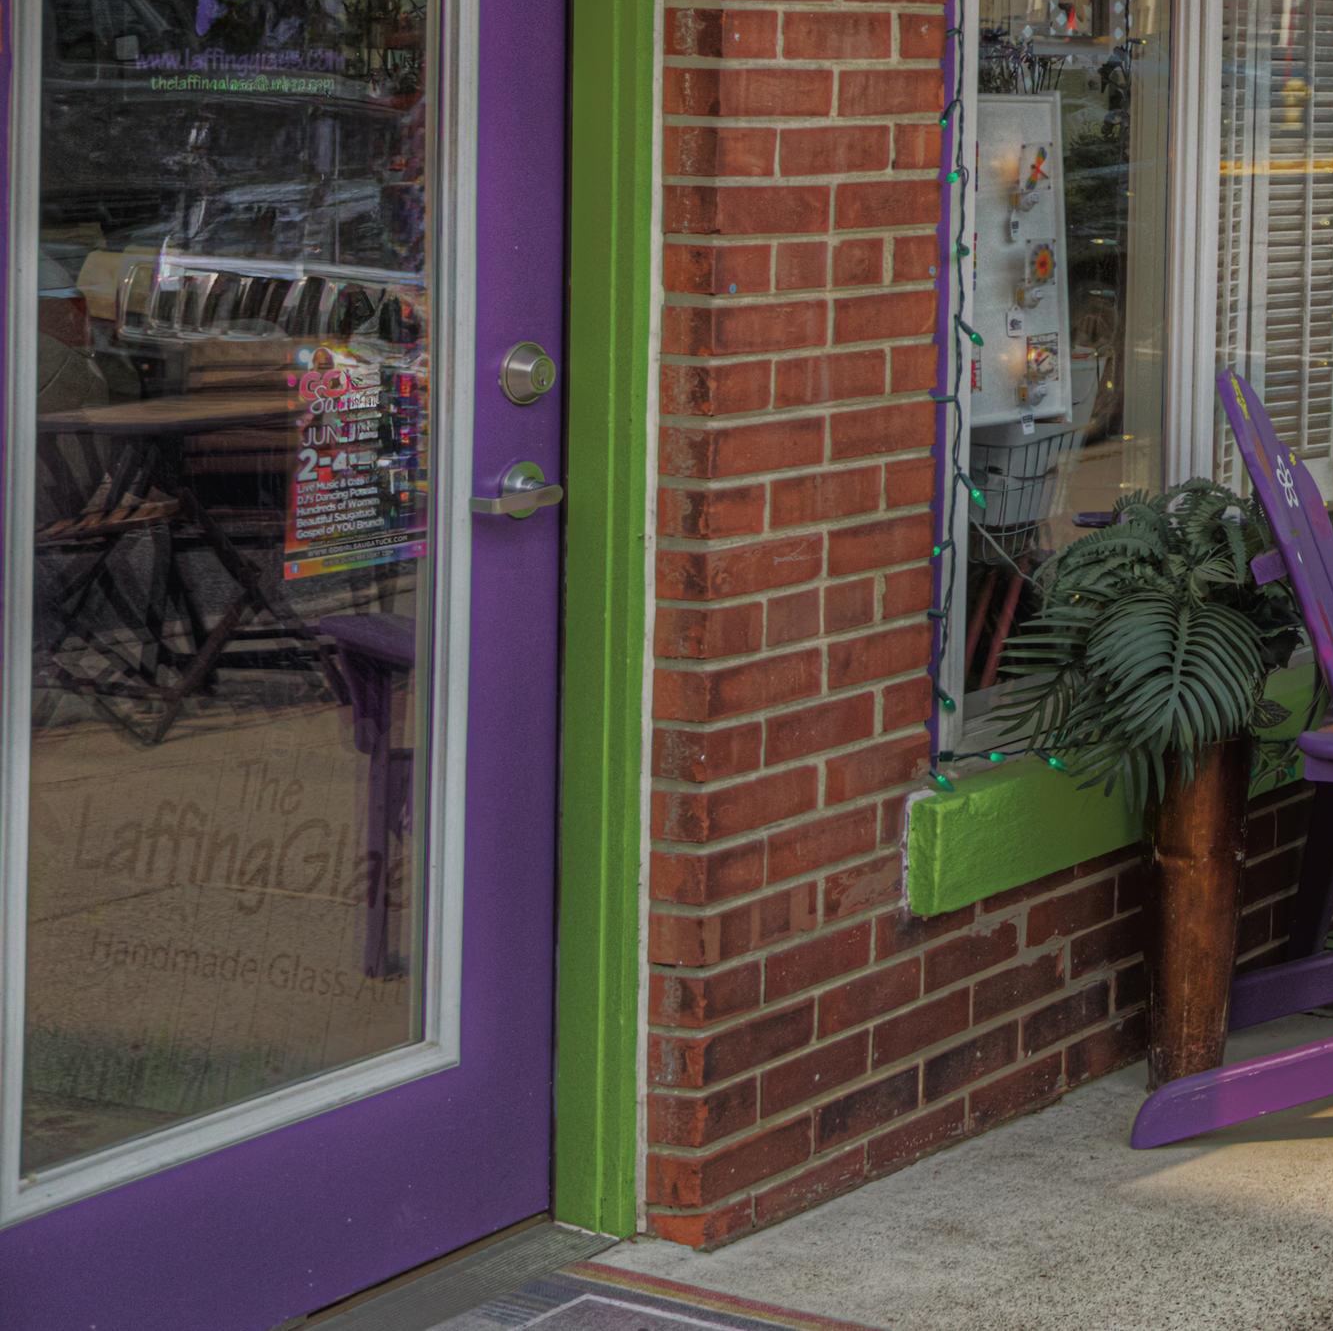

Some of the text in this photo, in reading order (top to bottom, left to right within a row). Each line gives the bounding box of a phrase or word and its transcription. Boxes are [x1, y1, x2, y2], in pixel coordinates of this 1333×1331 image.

[315, 490, 348, 502] Dancing
[316, 480, 339, 491] Music
[296, 497, 380, 517] Hundreds of Women
[296, 507, 377, 528] Beautiful Saugatuck
[296, 516, 385, 539] Gospel of YOU Brunch
[237, 758, 304, 816] The
[88, 931, 259, 985] Handmade
[267, 953, 349, 997] Glass
